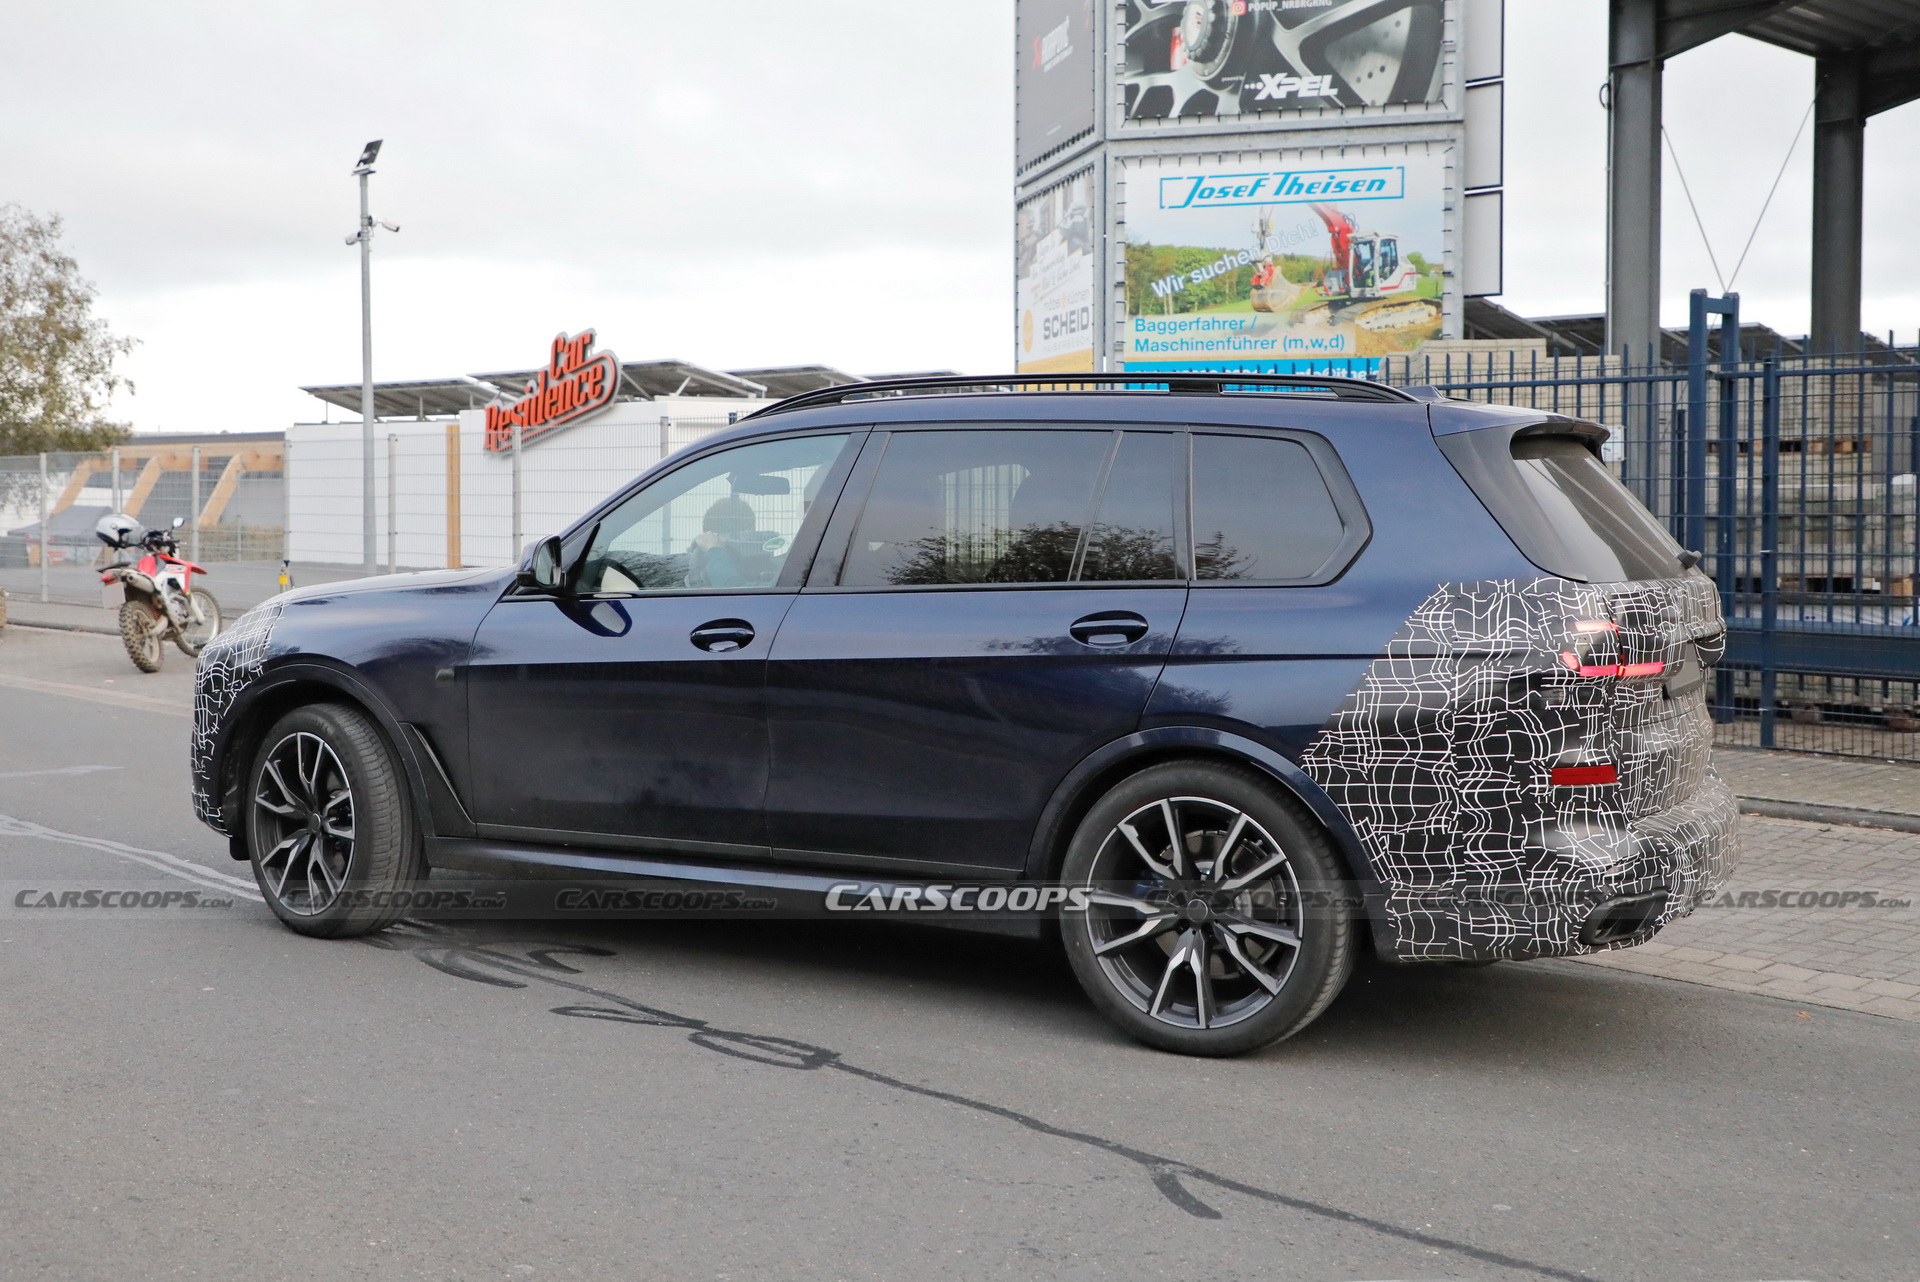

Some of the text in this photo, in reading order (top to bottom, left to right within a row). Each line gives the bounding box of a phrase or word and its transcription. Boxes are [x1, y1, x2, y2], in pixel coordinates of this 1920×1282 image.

[1254, 73, 1338, 100] XPEL
[1273, 172, 1386, 196] Theisen
[1151, 219, 1318, 298] Wir suchen Dich!
[1043, 306, 1090, 340] SCHEID
[1135, 315, 1257, 335] Baggerfahrer /
[550, 333, 593, 380] Car
[1135, 333, 1345, 353] Maschinenführer (m,w,d)
[484, 363, 604, 452] Residence
